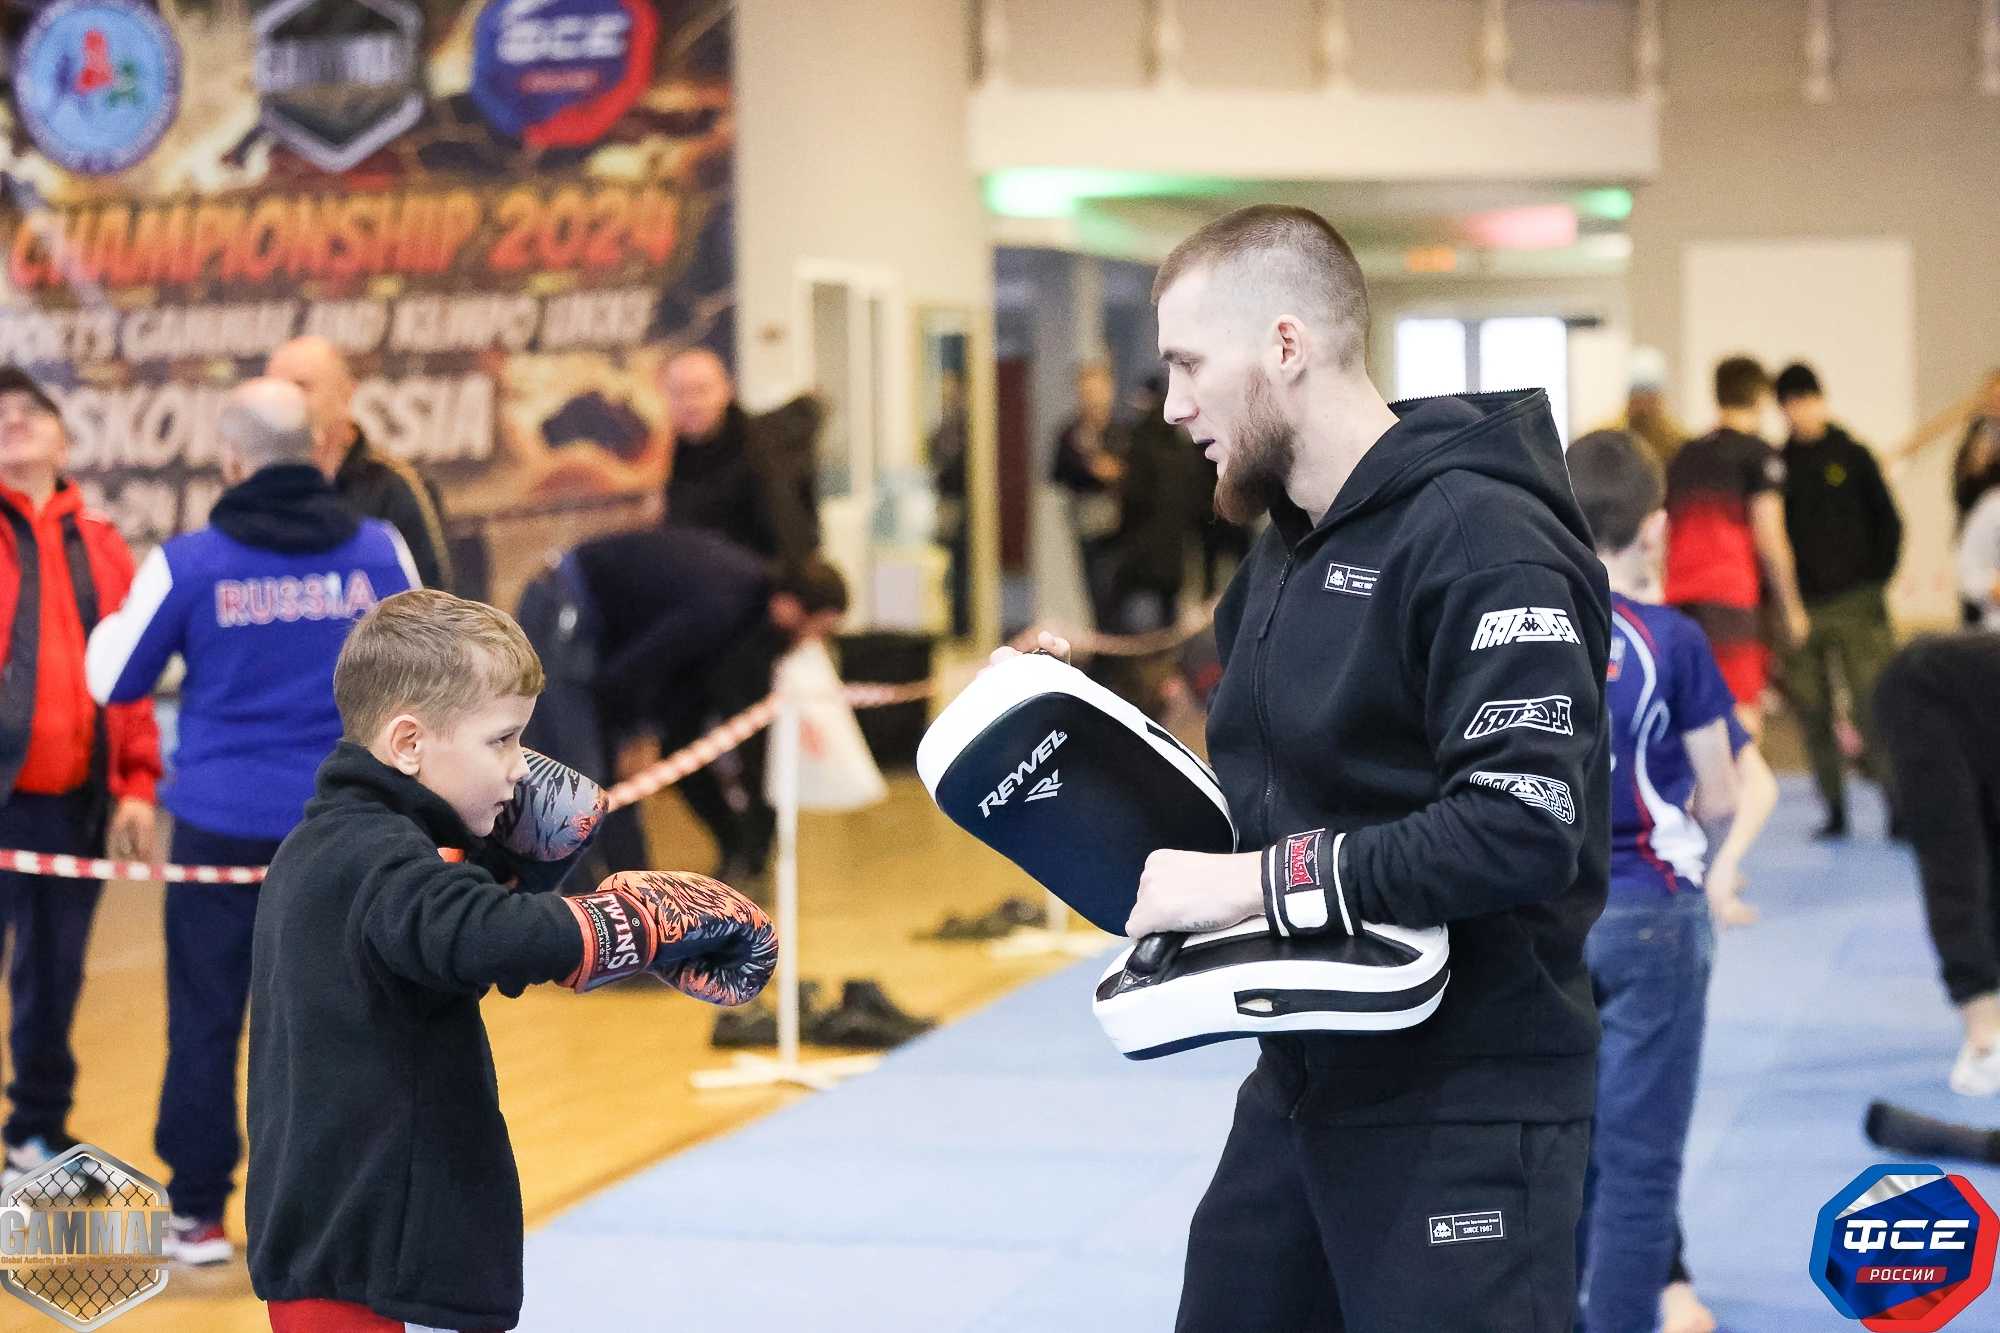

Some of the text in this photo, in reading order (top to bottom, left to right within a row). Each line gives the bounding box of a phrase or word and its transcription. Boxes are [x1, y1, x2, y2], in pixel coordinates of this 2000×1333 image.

[487, 186, 678, 272] 2024
[215, 569, 378, 628] RUSSIA
[977, 729, 1068, 819] REYVEL
[586, 892, 640, 970] TWINS
